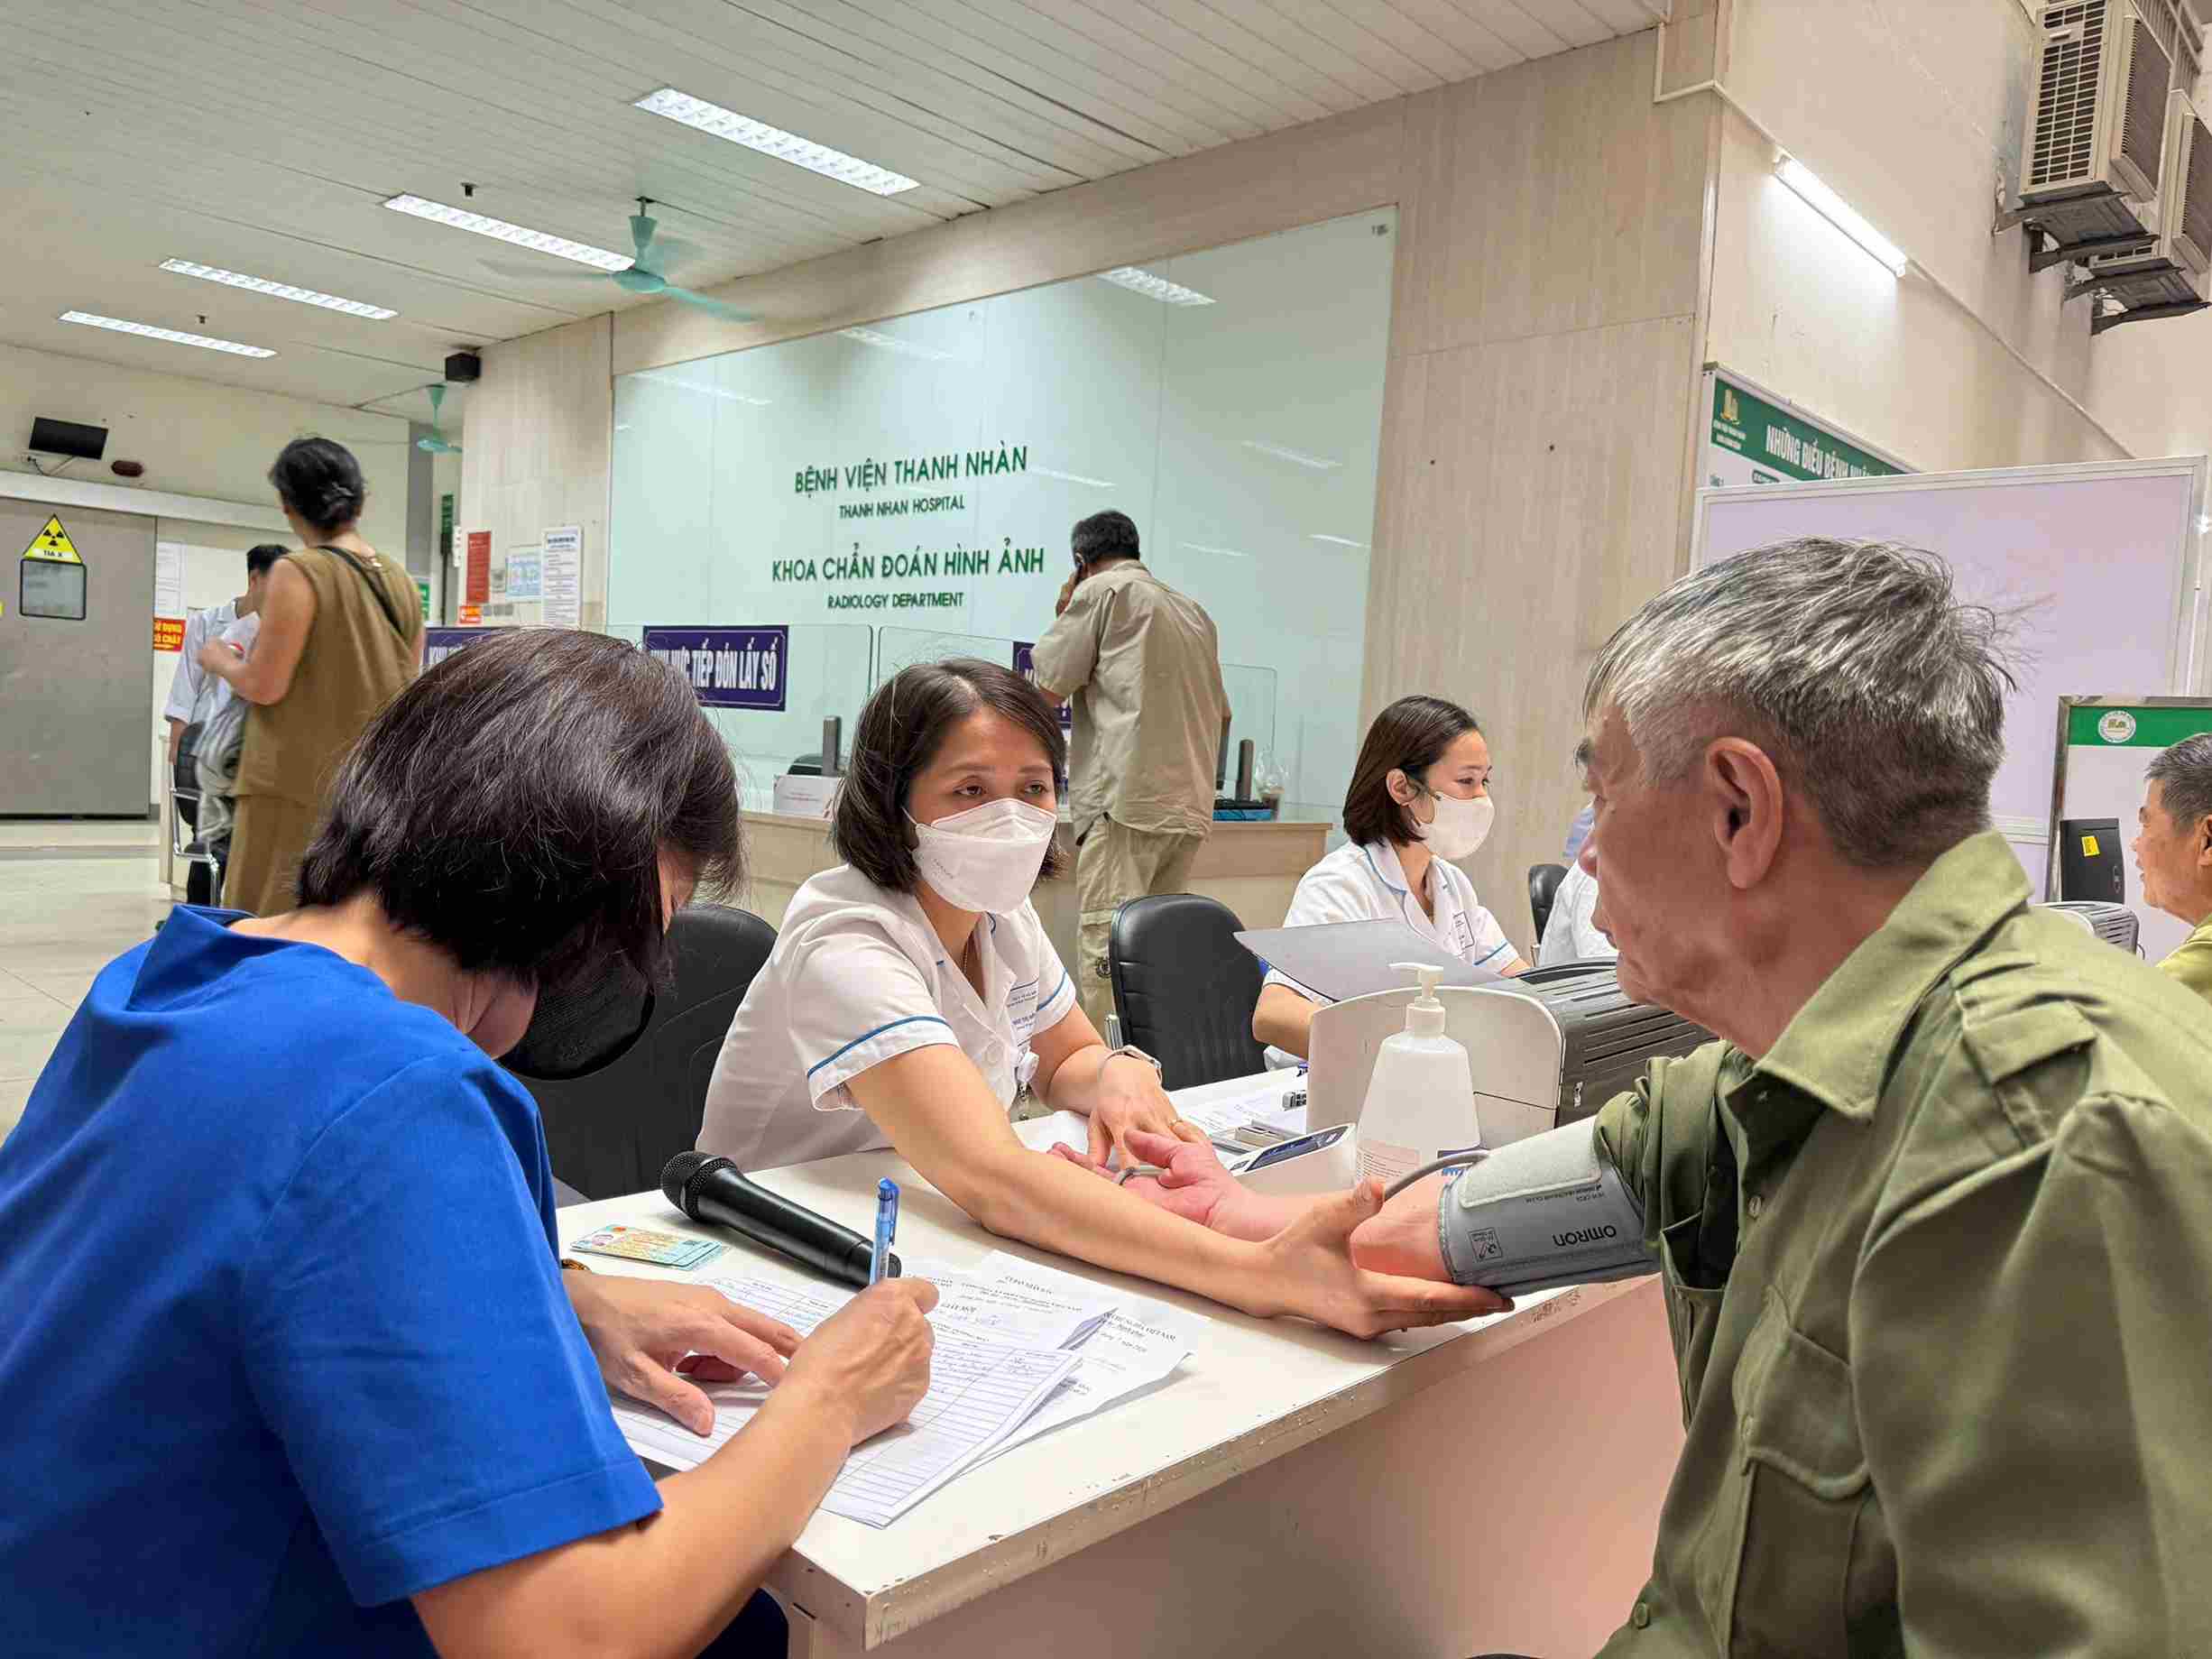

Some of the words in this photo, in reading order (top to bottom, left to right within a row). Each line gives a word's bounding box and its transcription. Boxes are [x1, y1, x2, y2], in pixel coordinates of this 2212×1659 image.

[795, 465, 837, 498] BỆNH
[844, 458, 887, 493] VIỆN
[894, 454, 958, 484] THANH
[965, 440, 1028, 477] NHÀN
[839, 502, 873, 519] THANH
[876, 500, 909, 517] NHAN
[912, 494, 965, 514] HOSPITAL
[772, 557, 817, 582] KHOA
[823, 542, 874, 580] CHẨN
[880, 545, 937, 577] ĐOÁN
[944, 543, 990, 576] HÌNH
[997, 538, 1045, 574] ẢNH
[827, 593, 889, 609] RADIOLOGY
[892, 592, 964, 608] DEPARTMENT
[692, 638, 714, 687] TIẾP
[739, 637, 760, 690] LẤY
[760, 637, 779, 691] SỐ
[1552, 1224, 1618, 1248] OMRON
